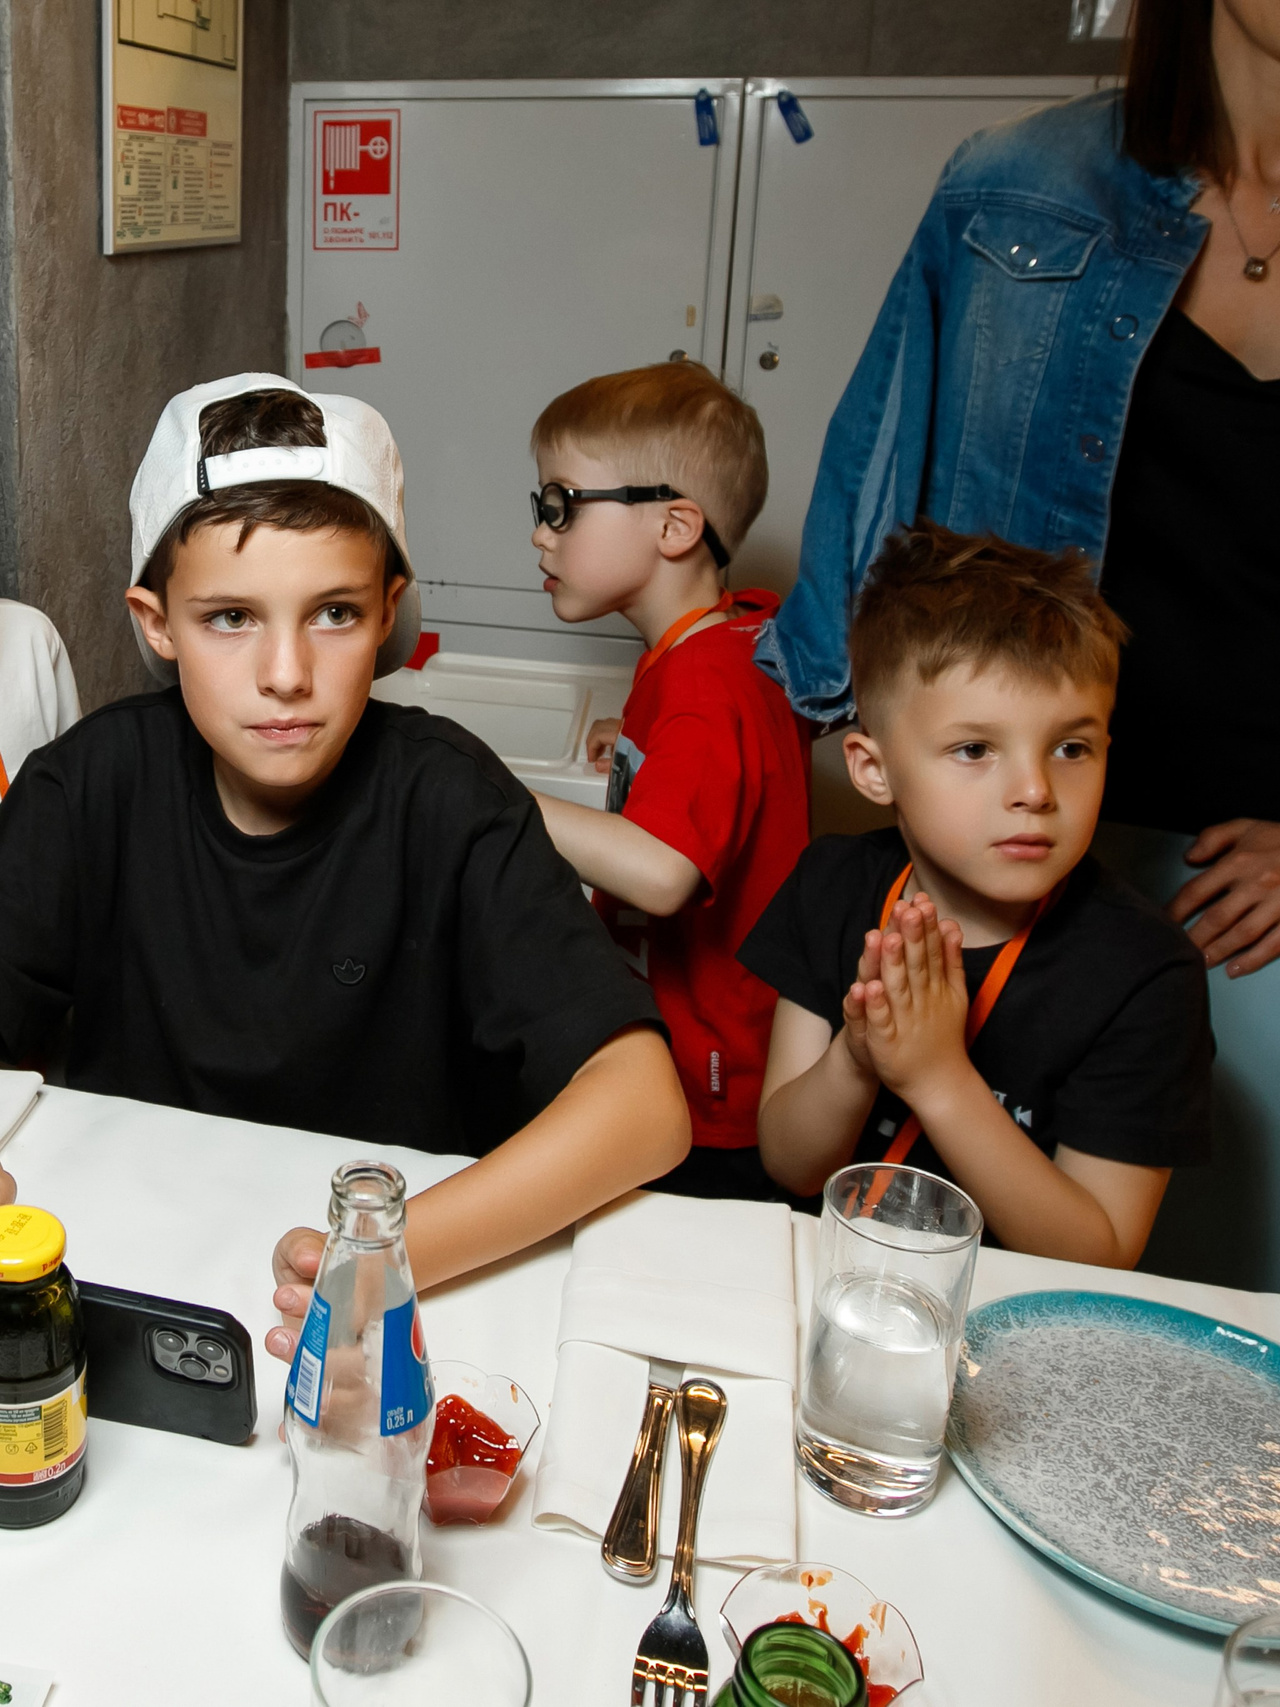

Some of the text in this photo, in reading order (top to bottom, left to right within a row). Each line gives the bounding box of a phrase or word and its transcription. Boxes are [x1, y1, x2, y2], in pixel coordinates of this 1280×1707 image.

[323, 202, 360, 222] ПК-
[710, 1051, 719, 1091] GULLIVER
[42, 1253, 62, 1272] pago
[387, 1413, 405, 1430] 0,25
